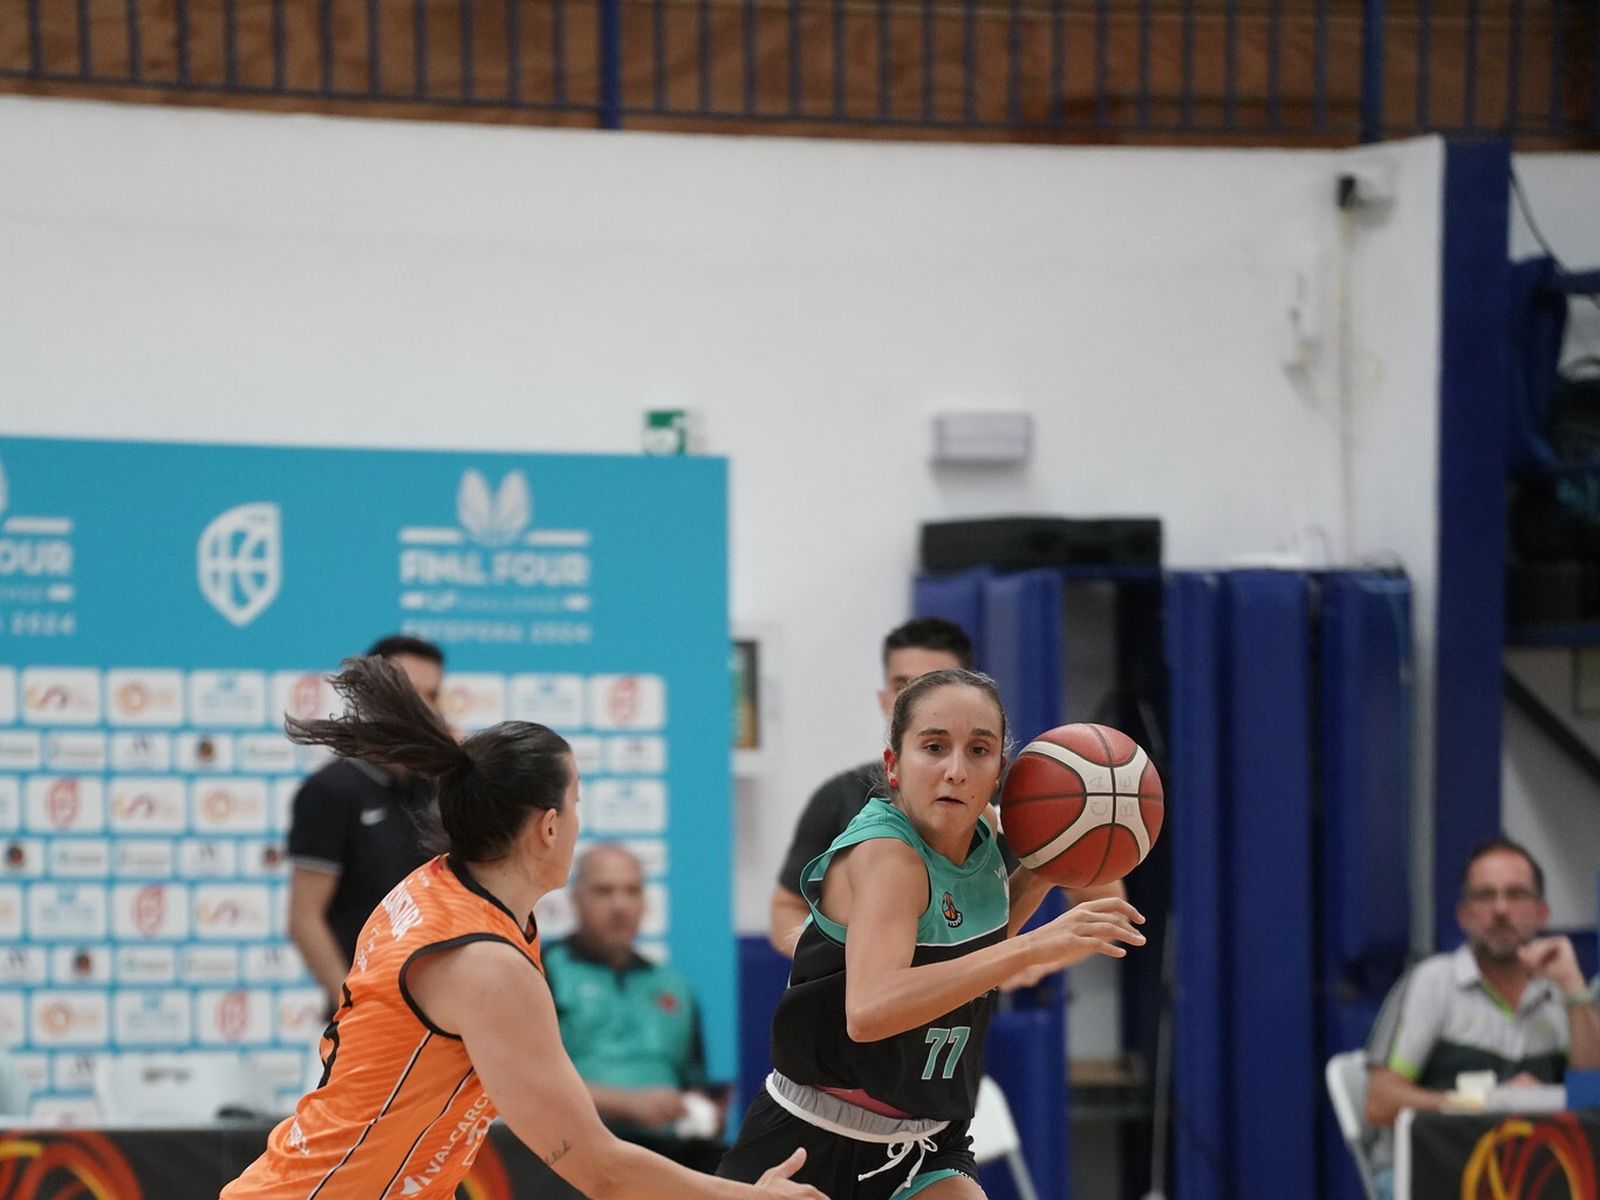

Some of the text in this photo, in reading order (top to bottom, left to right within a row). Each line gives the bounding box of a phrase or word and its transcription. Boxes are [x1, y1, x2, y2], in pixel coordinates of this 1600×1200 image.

[493, 552, 589, 586] FOUR
[921, 1026, 971, 1080] 77
[425, 1092, 488, 1174] VALCARC
